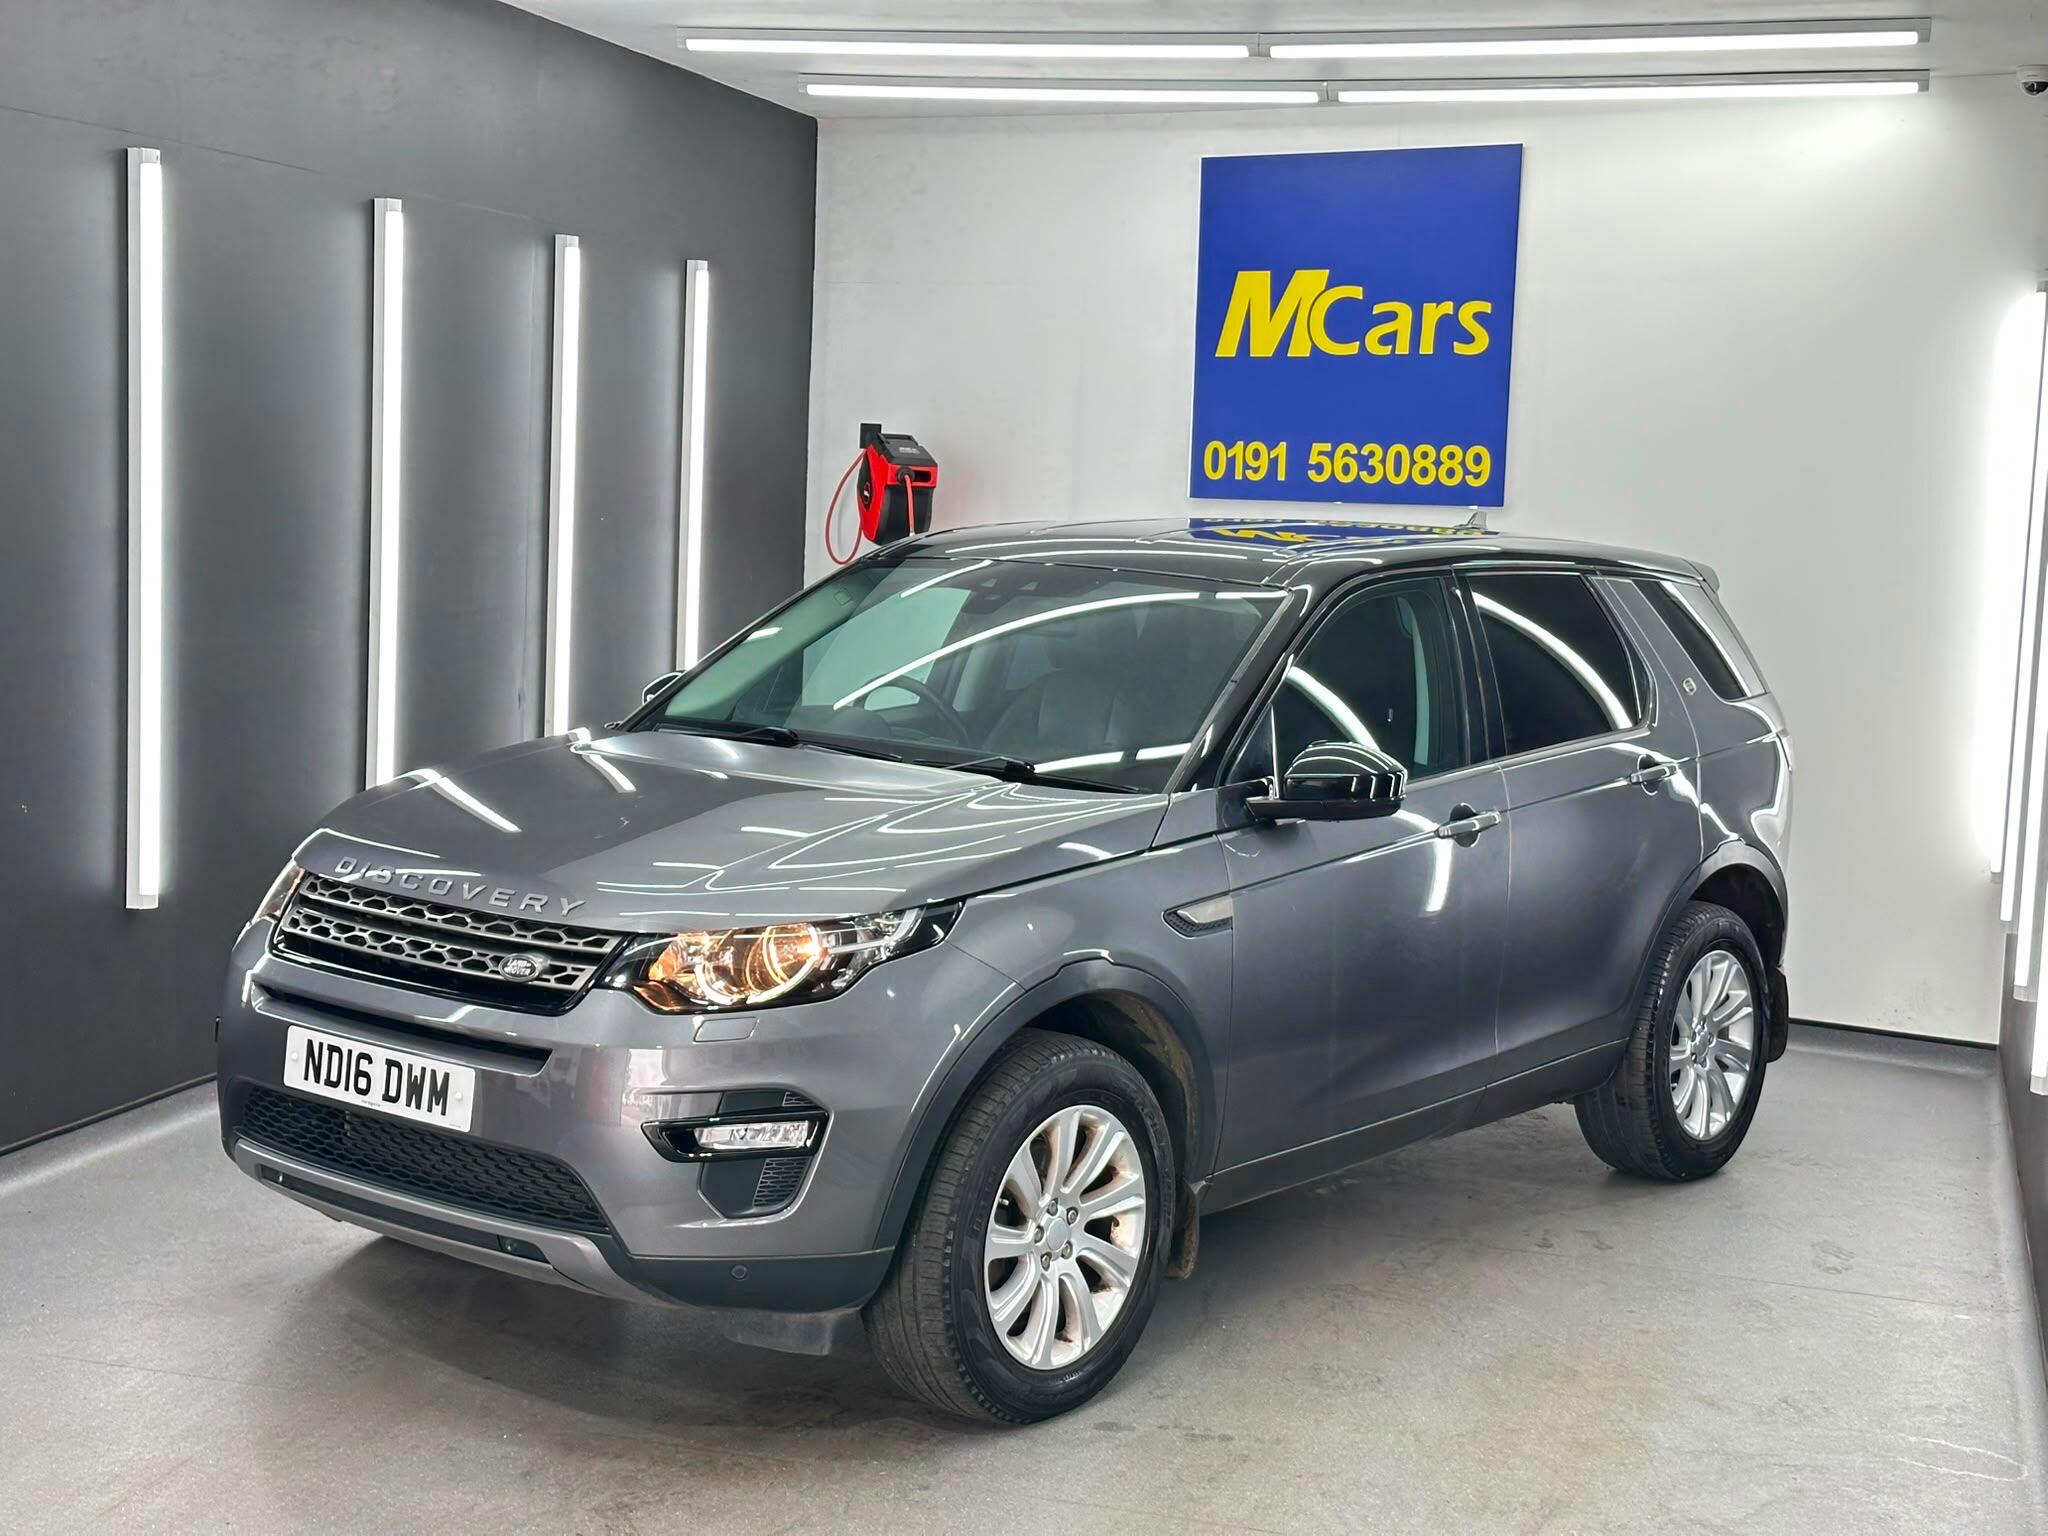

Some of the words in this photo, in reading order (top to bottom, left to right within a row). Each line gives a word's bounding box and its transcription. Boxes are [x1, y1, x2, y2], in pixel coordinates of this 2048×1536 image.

[1214, 268, 1493, 358] MCars
[1203, 440, 1287, 481] 0191
[1306, 442, 1492, 487] 5630889
[335, 856, 586, 917] DISCOVERY
[303, 1038, 372, 1097] ND16
[381, 1057, 451, 1117] DWM
